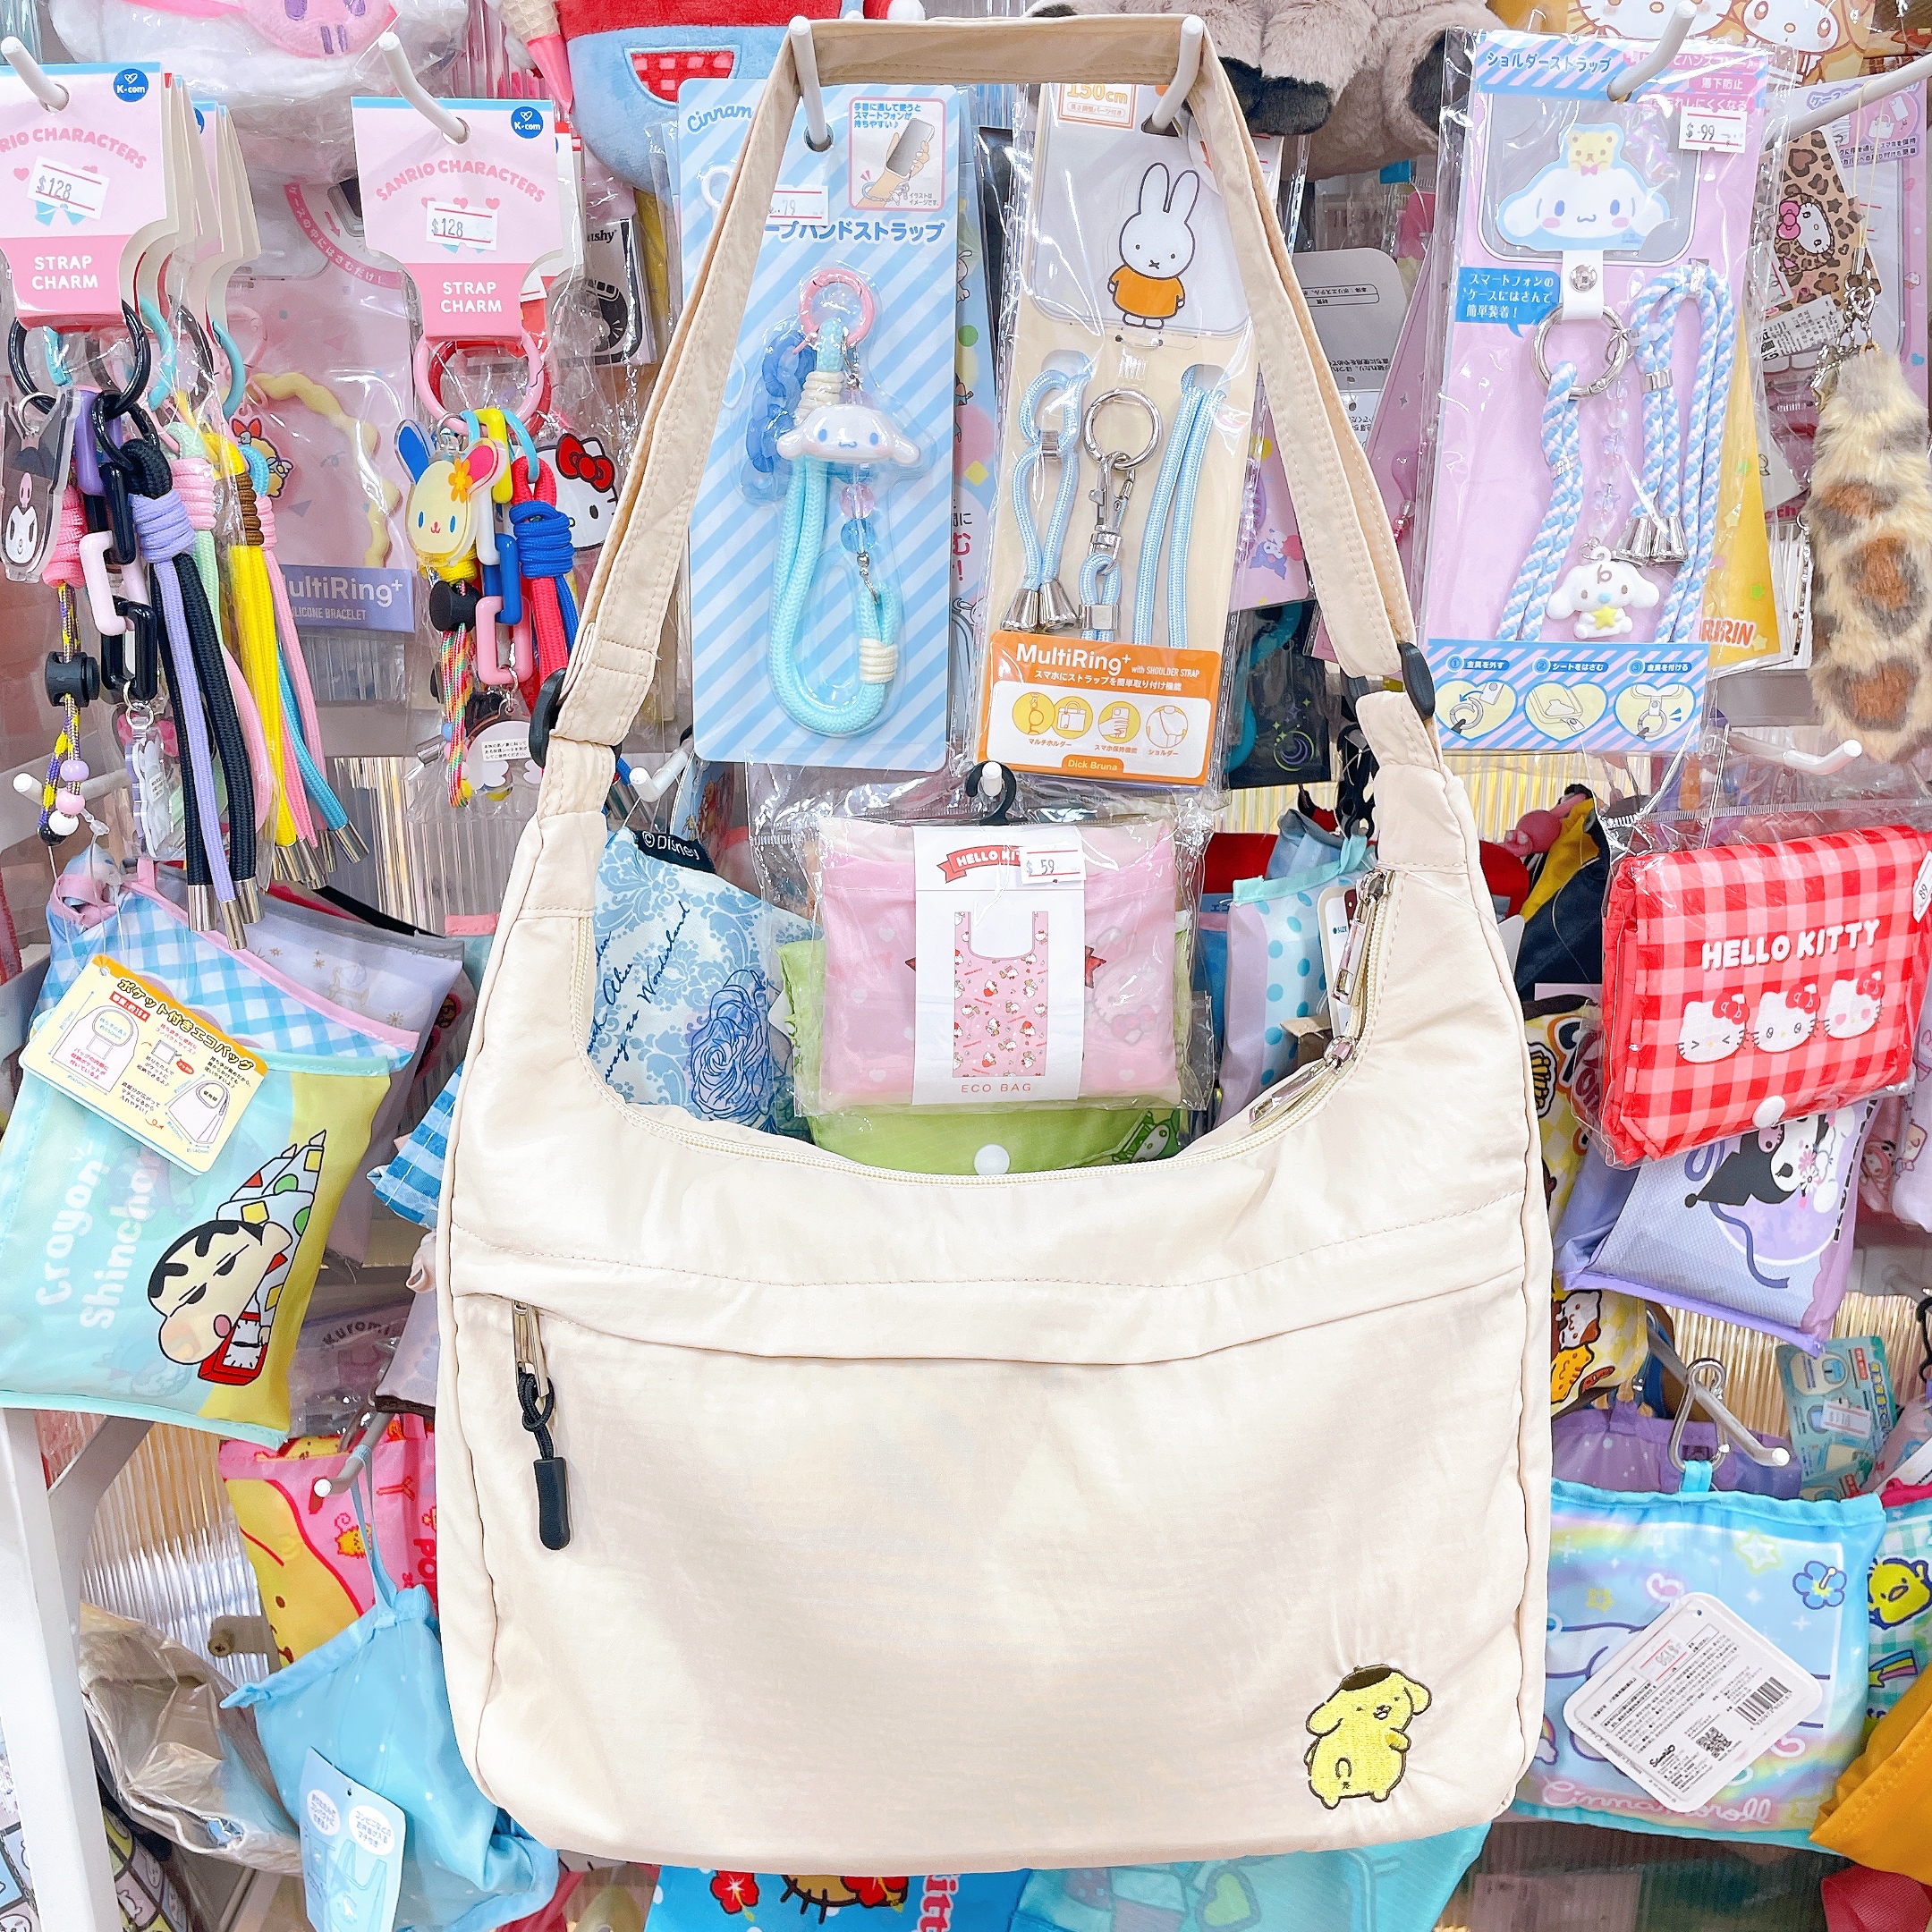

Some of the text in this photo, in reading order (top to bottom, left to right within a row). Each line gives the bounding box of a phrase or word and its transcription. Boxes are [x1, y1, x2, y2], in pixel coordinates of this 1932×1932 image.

[1487, 51, 1612, 73] ショルダーストラップ
[116, 84, 146, 95] K-com
[1701, 77, 1743, 89] 落下防止
[854, 112, 912, 120] スマートフォンが
[513, 121, 541, 131] K-com
[32, 127, 147, 169] CHARACTERS
[376, 159, 546, 203] SANRIO CHARACTERS
[431, 217, 463, 238] $128
[35, 255, 92, 271] STRAP
[31, 275, 97, 291] CHARM
[443, 281, 496, 295] STRAP
[1469, 273, 1555, 287] スマートフォンの
[1467, 287, 1553, 303] ケースにはさんで
[441, 300, 502, 313] CHARM
[283, 574, 402, 608] ultiRing+
[292, 606, 367, 621] ILICONE BRACELET
[1146, 666, 1179, 677] SHOULDER
[1180, 668, 1200, 679] STRAP
[1028, 738, 1072, 749] マルチホルダー
[1068, 758, 1118, 772] Dick Bruna
[955, 850, 998, 868] HELLO
[637, 900, 691, 1004] Wonderland
[1701, 919, 1881, 971] HELLO KITTY
[602, 963, 633, 1005] Alice
[117, 979, 256, 1072] ポケット付きエコバッグ
[962, 1082, 1031, 1093] ECO BAG
[35, 1160, 111, 1306] Crayon
